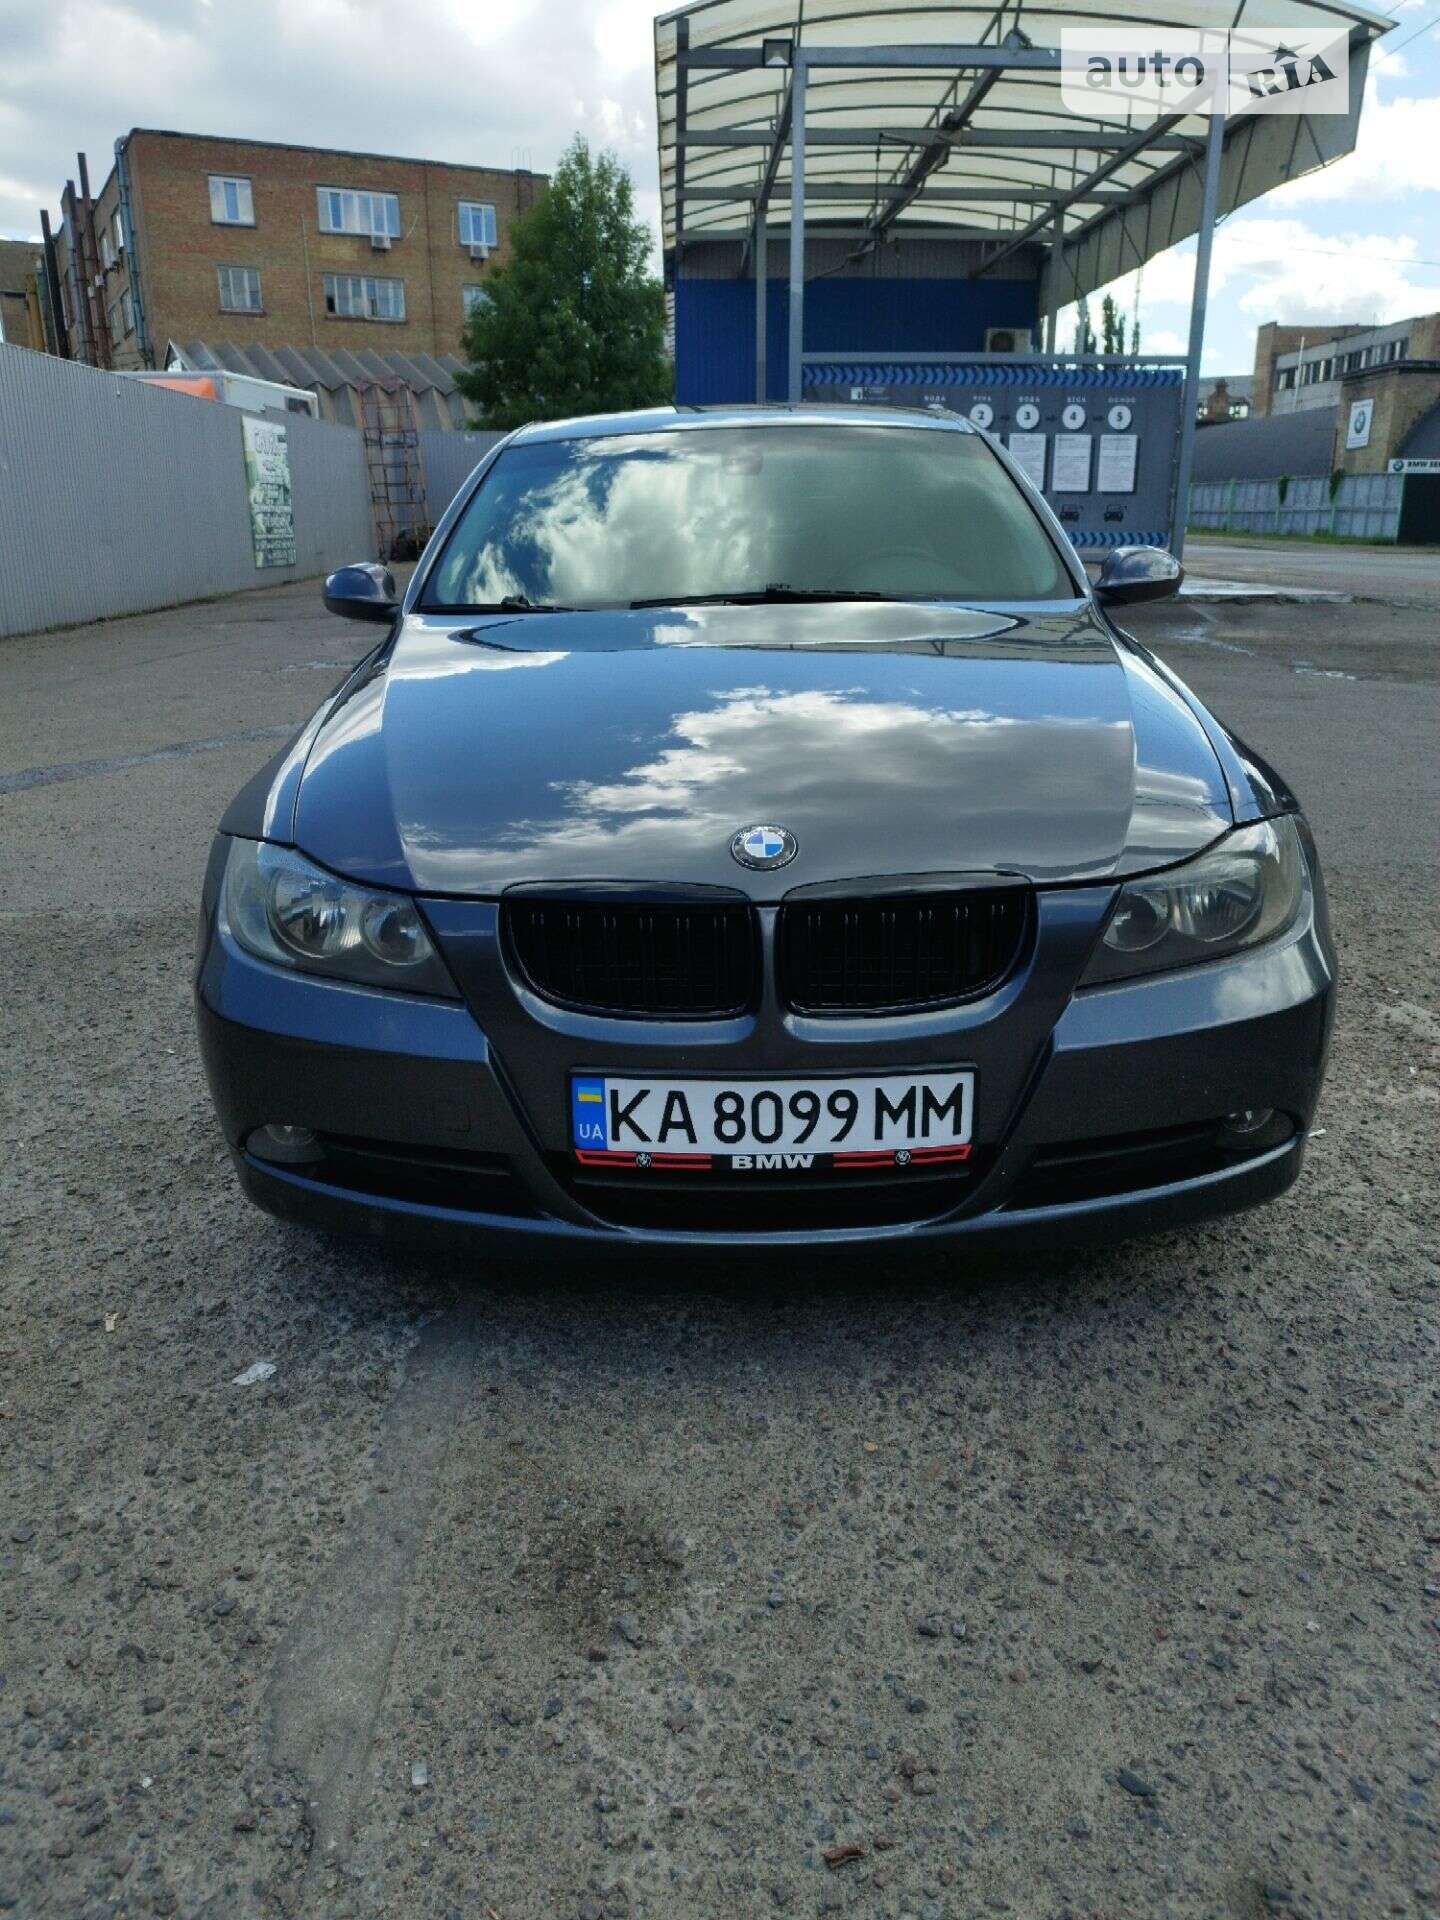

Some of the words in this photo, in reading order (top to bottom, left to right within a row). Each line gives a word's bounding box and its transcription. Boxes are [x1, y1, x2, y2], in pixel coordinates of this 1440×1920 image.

[977, 410, 985, 420] 2
[1024, 411, 1031, 420] 3
[1069, 411, 1076, 421] 4
[1116, 411, 1123, 422] 5
[610, 1088, 698, 1144] KA
[713, 1088, 859, 1144] 8099
[875, 1082, 963, 1141] MM
[579, 1123, 604, 1140] UA
[731, 1154, 815, 1170] BMW
